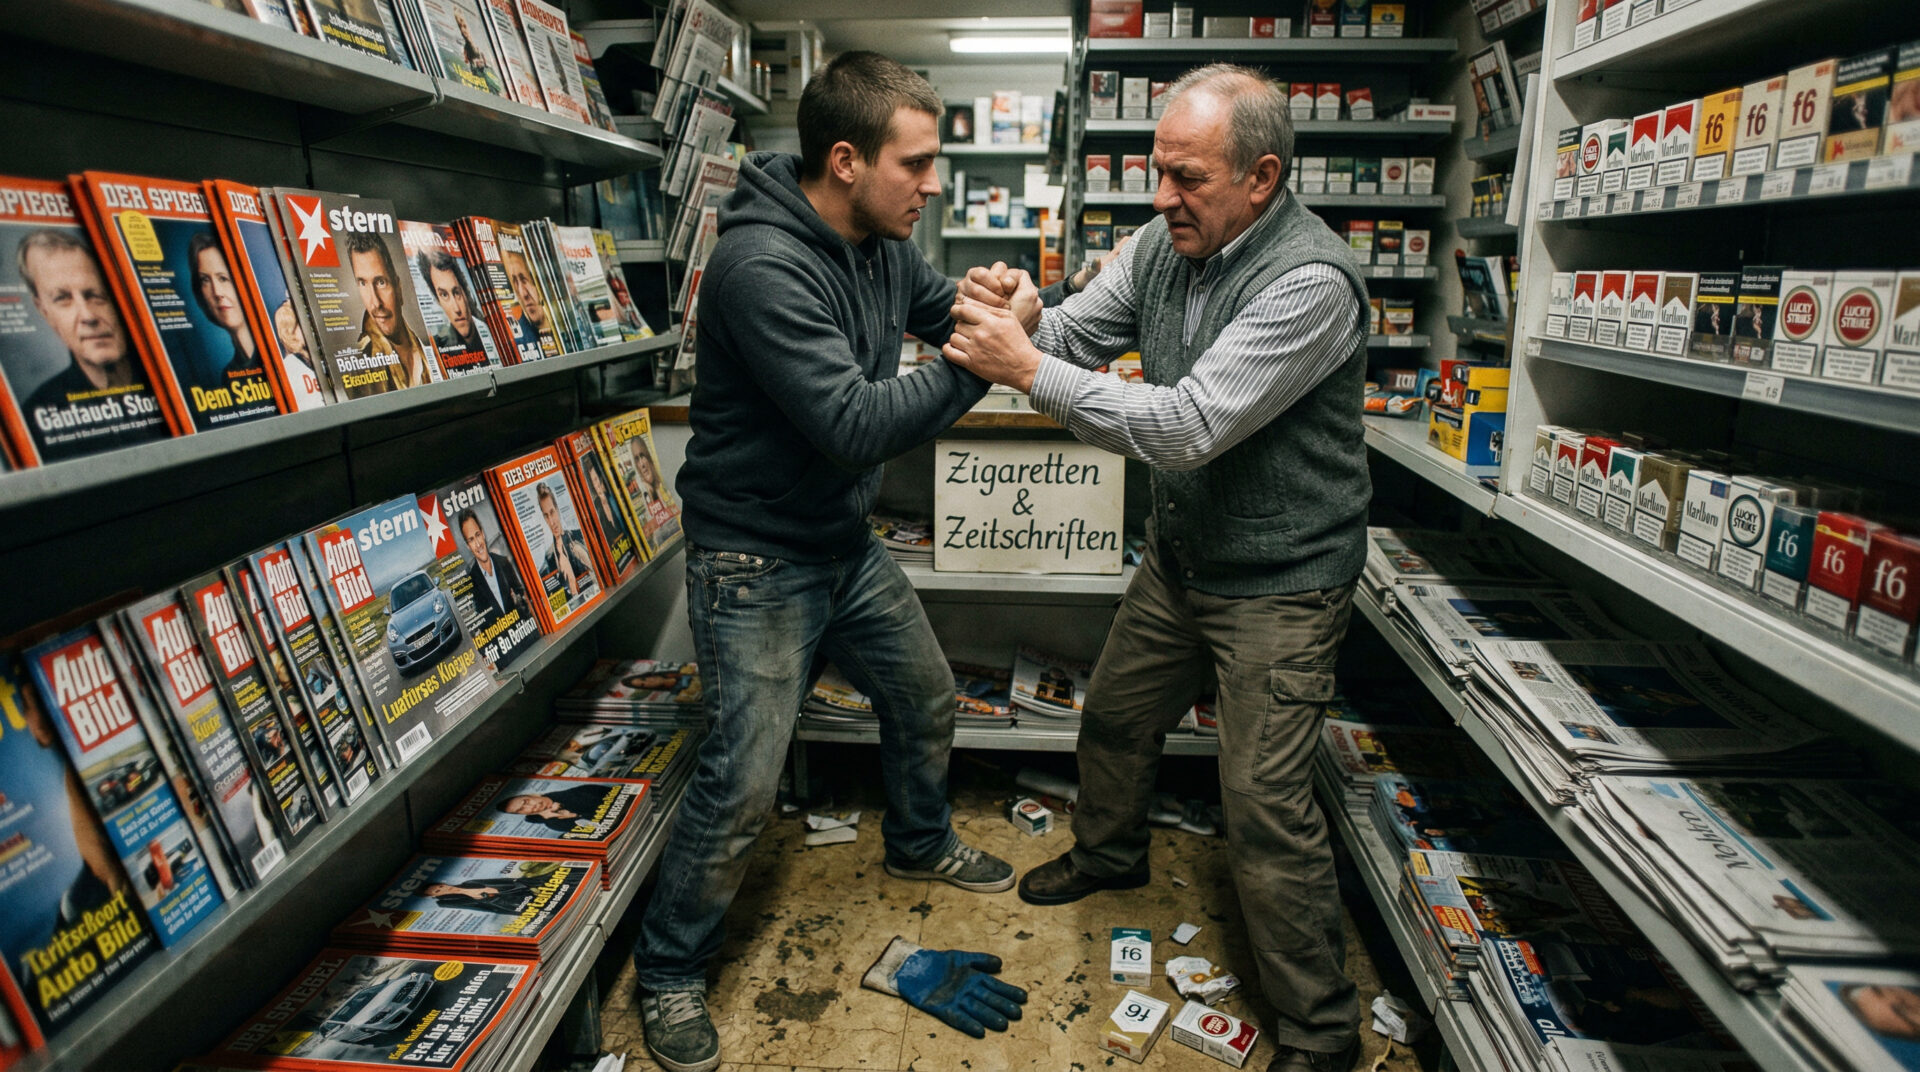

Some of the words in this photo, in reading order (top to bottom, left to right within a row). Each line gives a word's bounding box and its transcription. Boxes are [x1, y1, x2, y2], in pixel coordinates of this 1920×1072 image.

[1746, 103, 1768, 137] f6
[1792, 88, 1817, 125] f6
[1705, 113, 1725, 144] f6
[99, 183, 145, 208] DER
[329, 206, 394, 234] stern
[1787, 313, 1813, 325] STRIKE
[1789, 302, 1813, 314] LUCKY
[1841, 316, 1872, 330] STRIKE
[1843, 305, 1872, 317] LUCKY
[1894, 322, 1920, 347] Mar
[191, 386, 233, 412] Dem
[502, 465, 525, 488] DER
[523, 454, 557, 481] SPIEGEL
[946, 451, 1101, 496] Zigaretten
[443, 483, 486, 517] stern
[1012, 488, 1034, 516] &
[1736, 507, 1758, 524] LUCKY
[358, 508, 419, 551] stern
[943, 516, 1118, 559] Zeitschriften
[1777, 530, 1799, 558] f6
[323, 535, 361, 579] Auto
[1822, 545, 1845, 575] f6
[335, 574, 373, 616] Bild
[1873, 559, 1907, 600] f6
[52, 644, 115, 706] Auto
[68, 684, 133, 747] Bild
[380, 857, 442, 909] stern
[37, 951, 97, 1010] Auto
[97, 911, 142, 961] Bild
[1121, 946, 1142, 961] f6
[1125, 1003, 1150, 1022] f6
